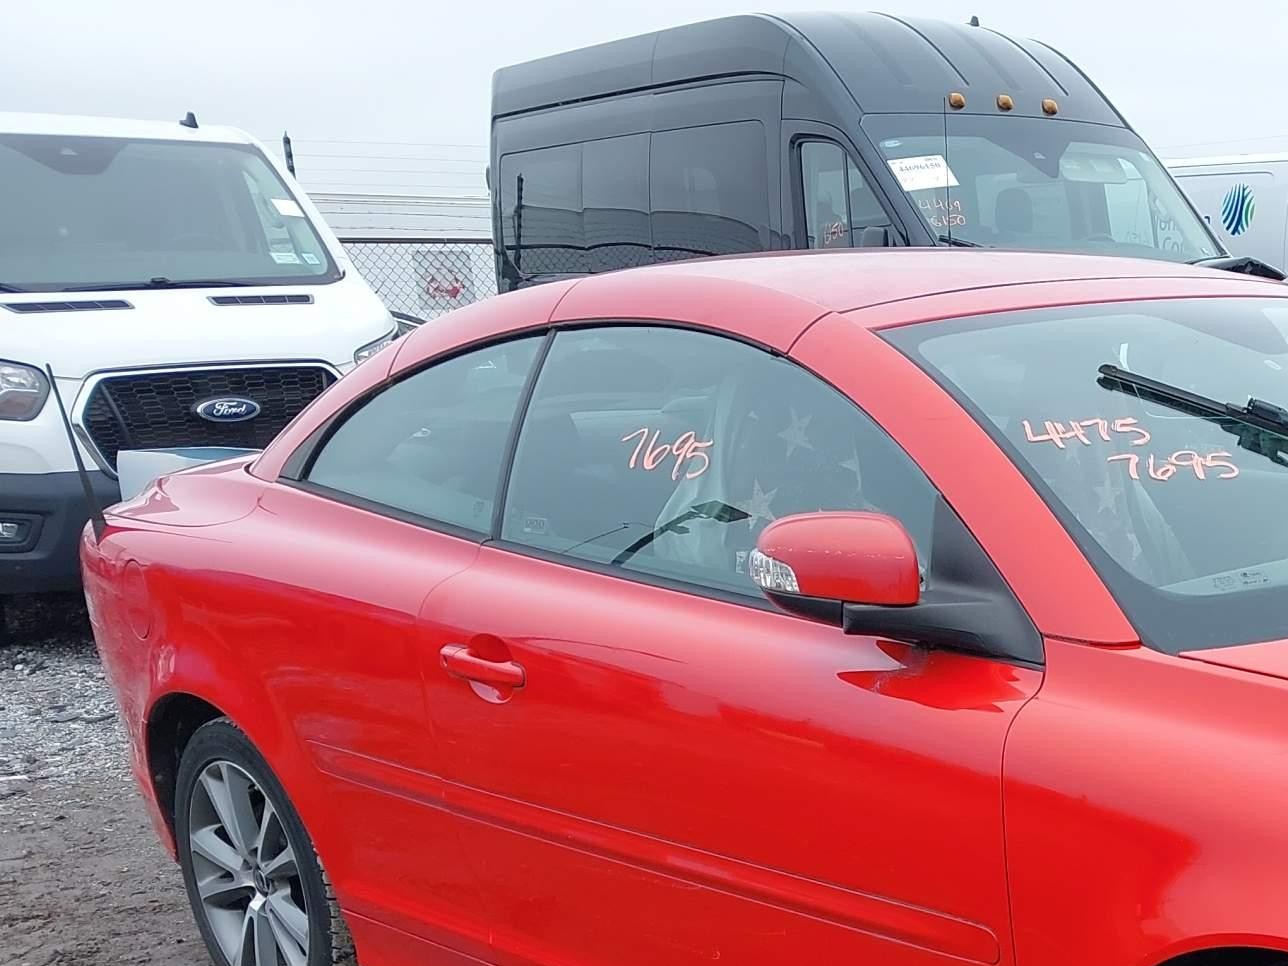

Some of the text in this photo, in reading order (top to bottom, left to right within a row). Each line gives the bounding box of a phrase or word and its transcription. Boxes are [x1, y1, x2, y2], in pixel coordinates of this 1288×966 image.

[213, 401, 247, 417] Ford
[1022, 417, 1151, 449] 4475
[620, 427, 714, 481] 7695
[1107, 450, 1240, 481] 7695
